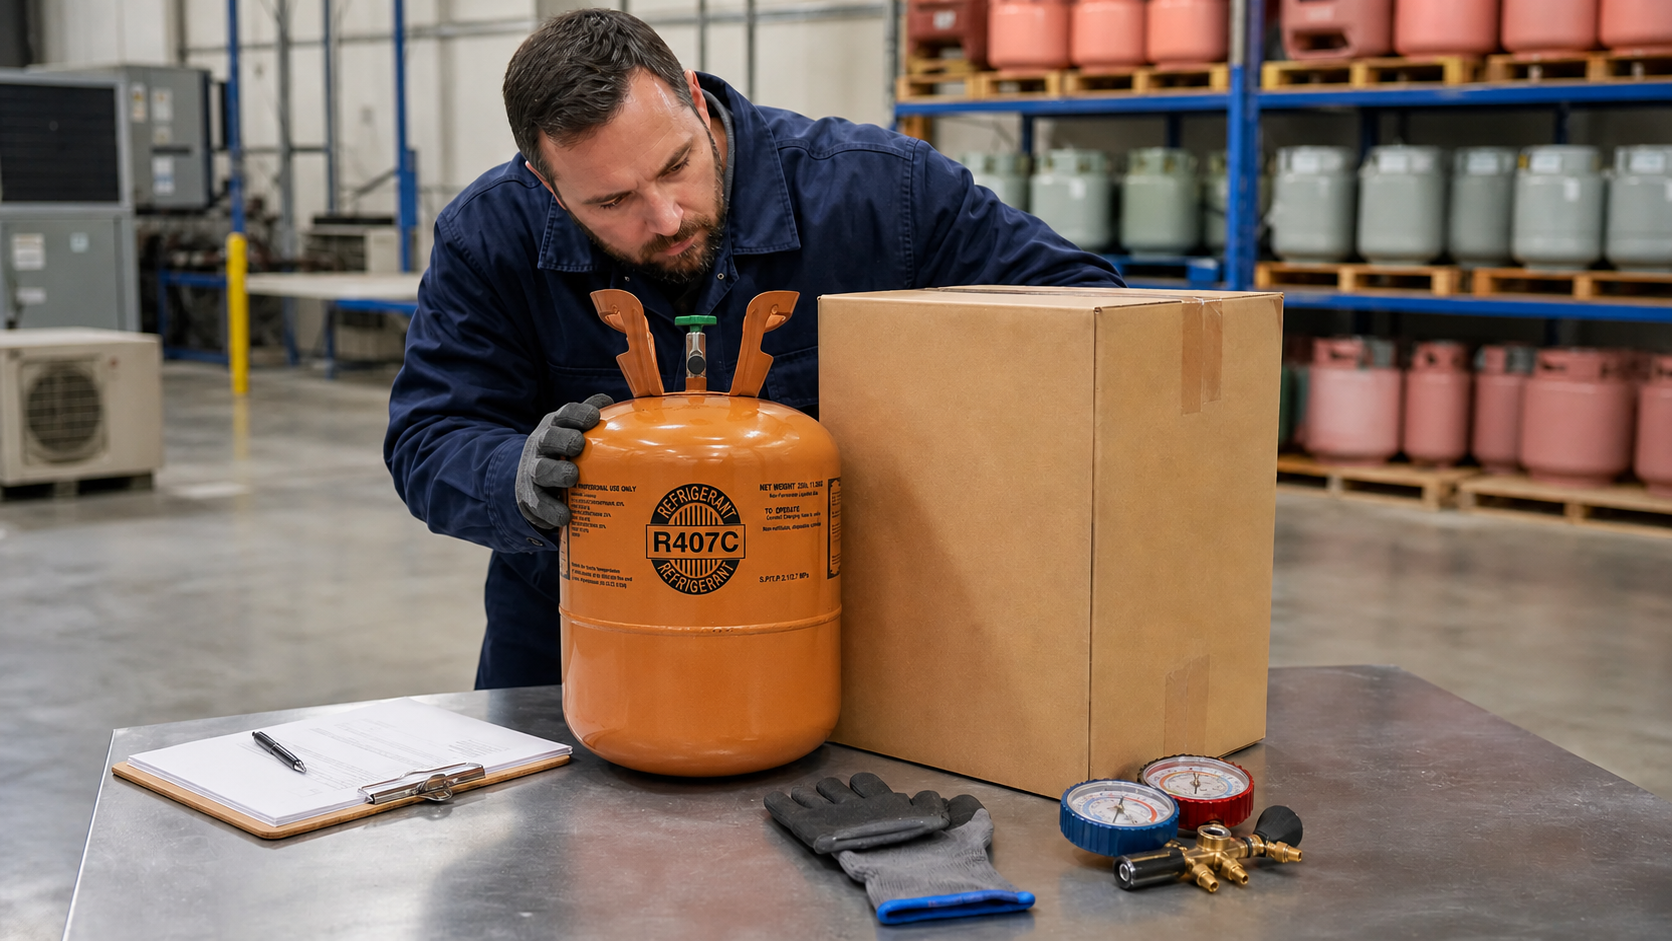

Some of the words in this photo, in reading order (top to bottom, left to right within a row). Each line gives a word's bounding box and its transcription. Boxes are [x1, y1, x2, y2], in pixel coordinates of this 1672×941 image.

[620, 485, 637, 493] ONLY
[759, 483, 772, 491] NET
[773, 482, 796, 491] WEIGHT
[657, 486, 737, 519] REFRIGERANT
[653, 530, 739, 553] R407C
[657, 561, 734, 593] REFRIGERANT
